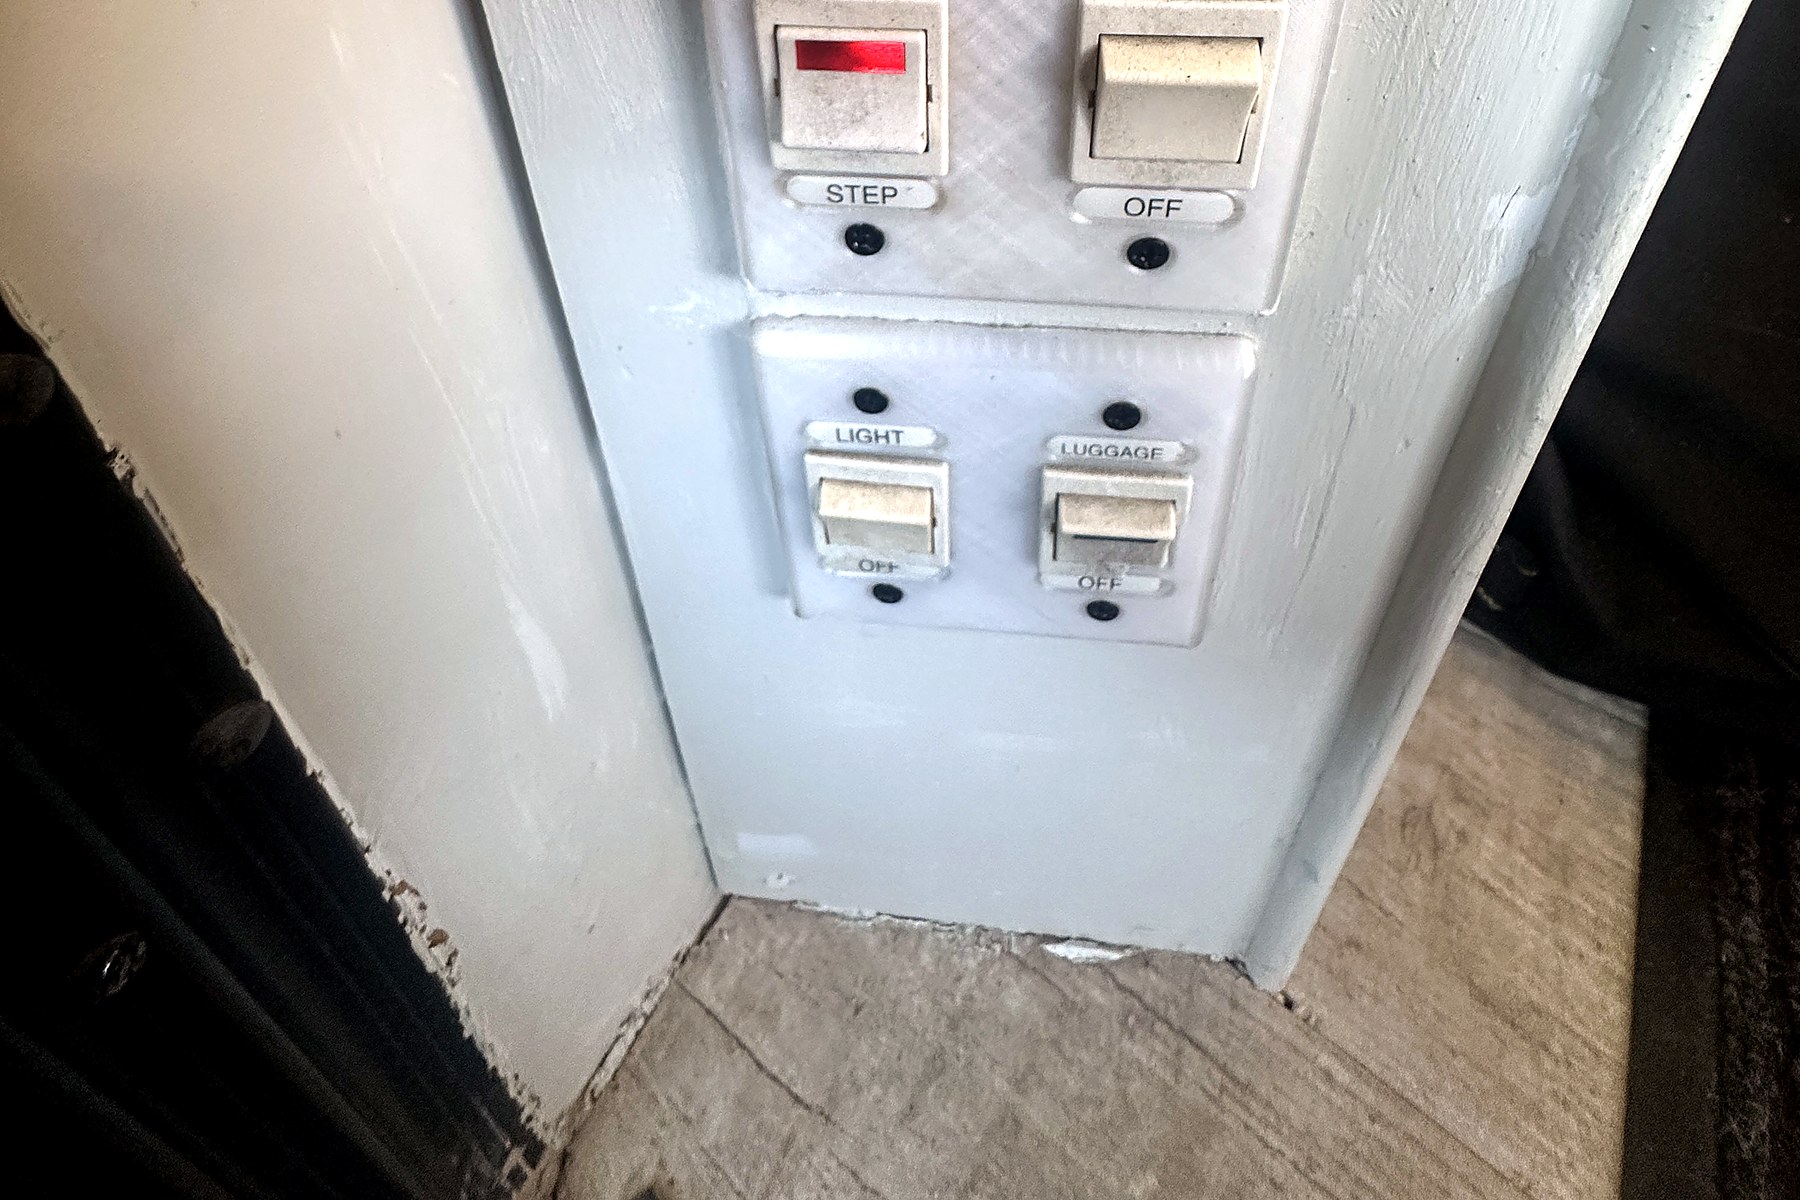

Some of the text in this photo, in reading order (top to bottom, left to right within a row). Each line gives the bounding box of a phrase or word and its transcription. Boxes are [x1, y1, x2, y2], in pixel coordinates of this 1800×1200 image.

[826, 183, 899, 205] STEP
[1123, 196, 1184, 218] OFF
[834, 427, 905, 444] LIGHT
[1060, 442, 1165, 460] LUGGAGE
[1078, 575, 1123, 591] OFF
